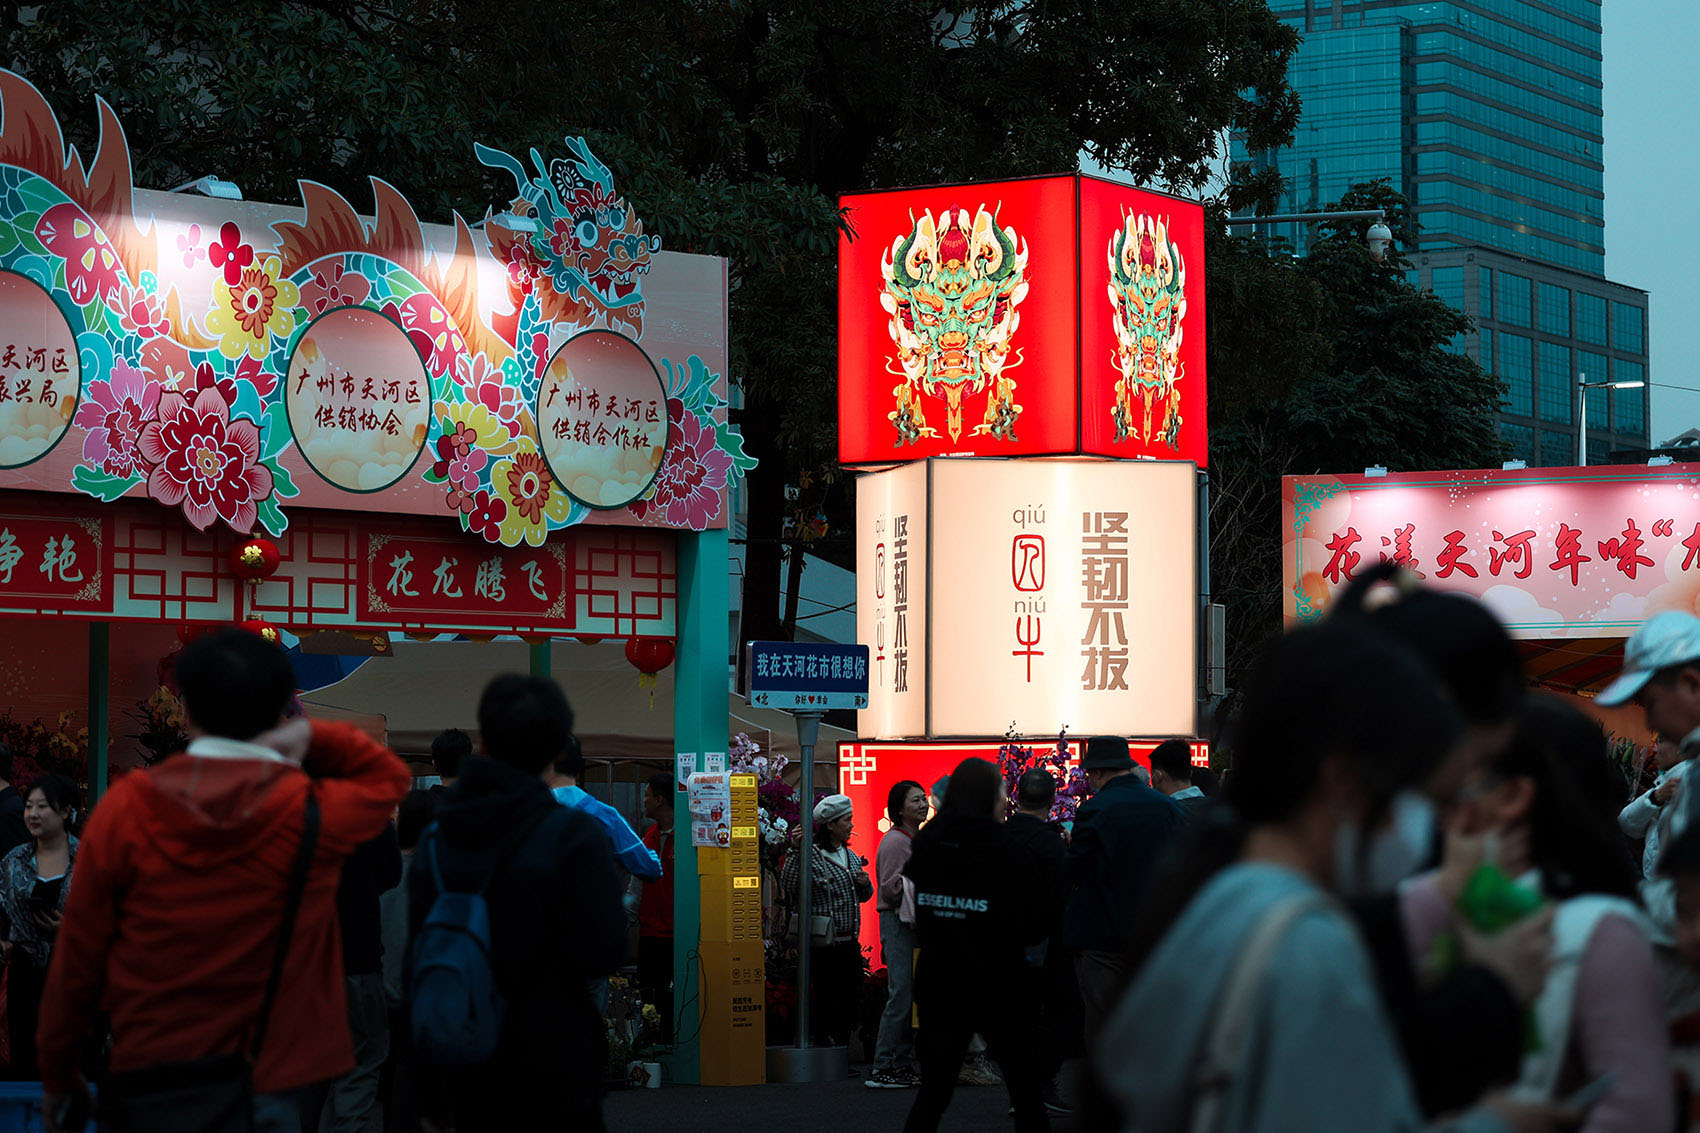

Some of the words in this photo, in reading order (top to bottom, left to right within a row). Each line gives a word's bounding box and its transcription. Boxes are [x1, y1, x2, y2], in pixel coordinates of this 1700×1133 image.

[1, 344, 69, 373] 天河区
[296, 367, 421, 404] 广州市天河区
[546, 382, 660, 423] 广州市天河区
[314, 404, 402, 436] 供销协会
[552, 417, 651, 451] 供销合作社
[1012, 503, 1046, 529] qiú
[386, 550, 549, 603] 花龙腾飞
[894, 514, 908, 694] 坚韧不拔
[1014, 595, 1046, 614] niú
[1081, 511, 1129, 691] 坚韧不拔
[757, 652, 866, 680] 我在天河花市很想你
